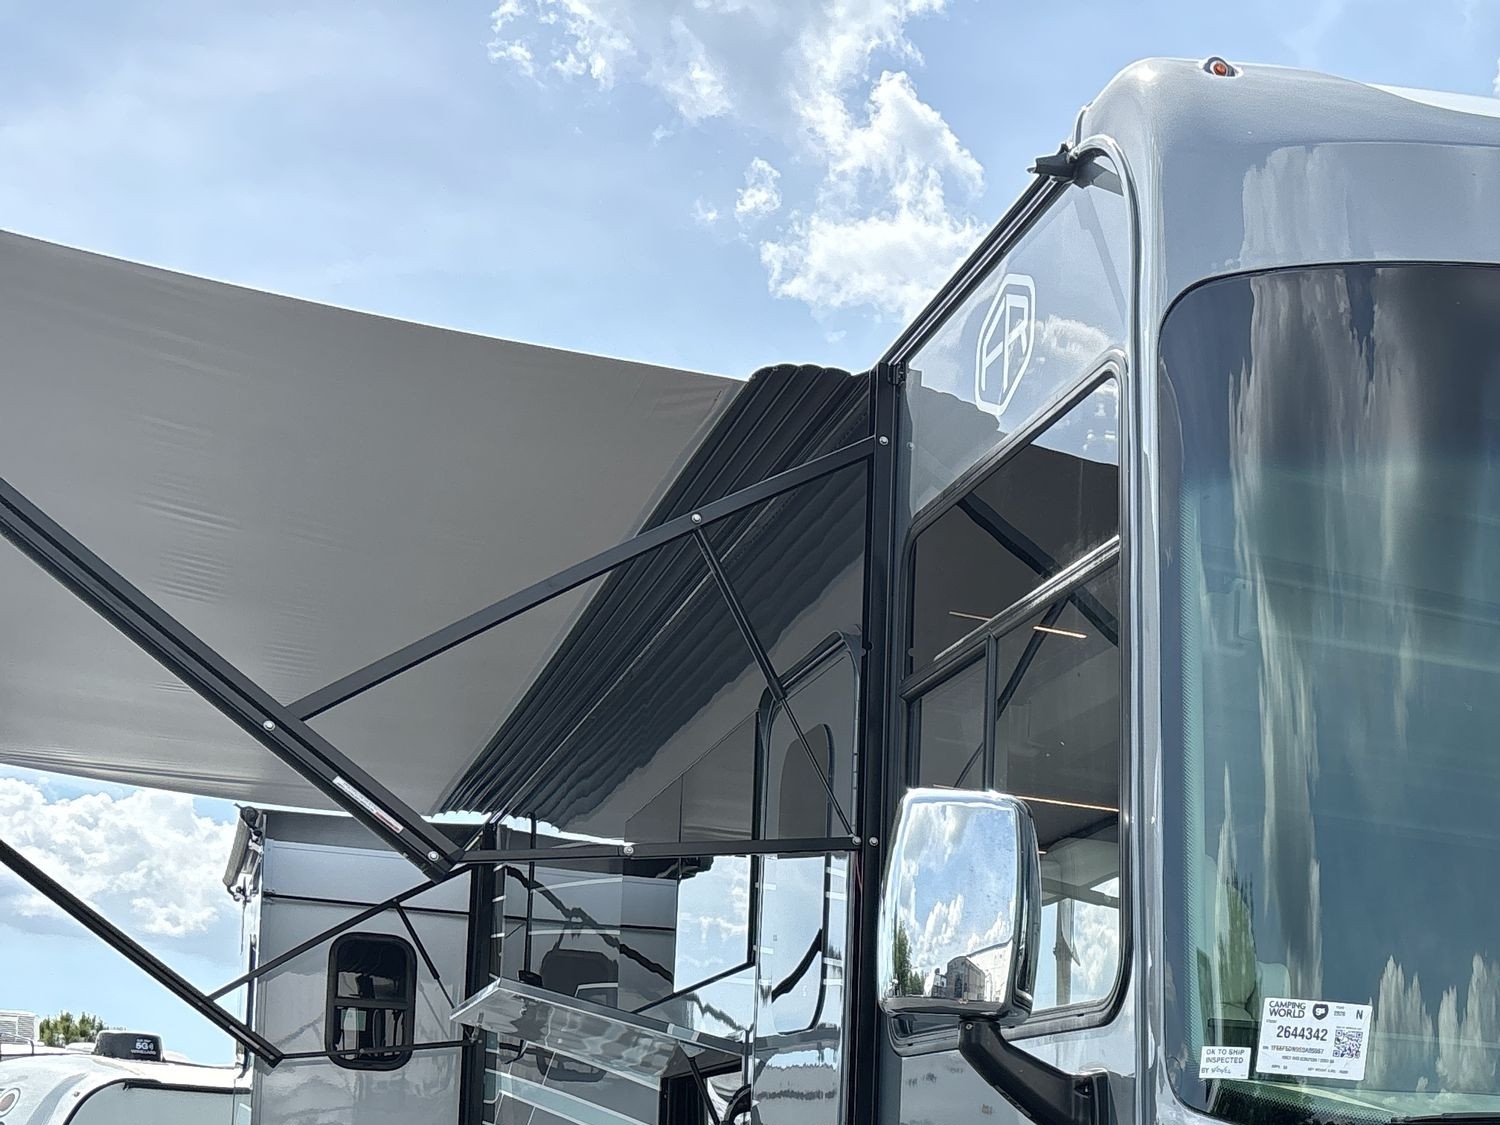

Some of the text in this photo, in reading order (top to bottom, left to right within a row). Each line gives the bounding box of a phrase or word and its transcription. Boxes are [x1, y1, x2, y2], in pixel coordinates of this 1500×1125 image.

[1269, 1000, 1306, 1010] CAMPING
[1269, 1008, 1305, 1019] WORLD
[1355, 1009, 1364, 1020] N
[1276, 1025, 1328, 1041] 2644342
[1228, 1048, 1245, 1056] SHIP
[1205, 1056, 1244, 1064] INSPECTED
